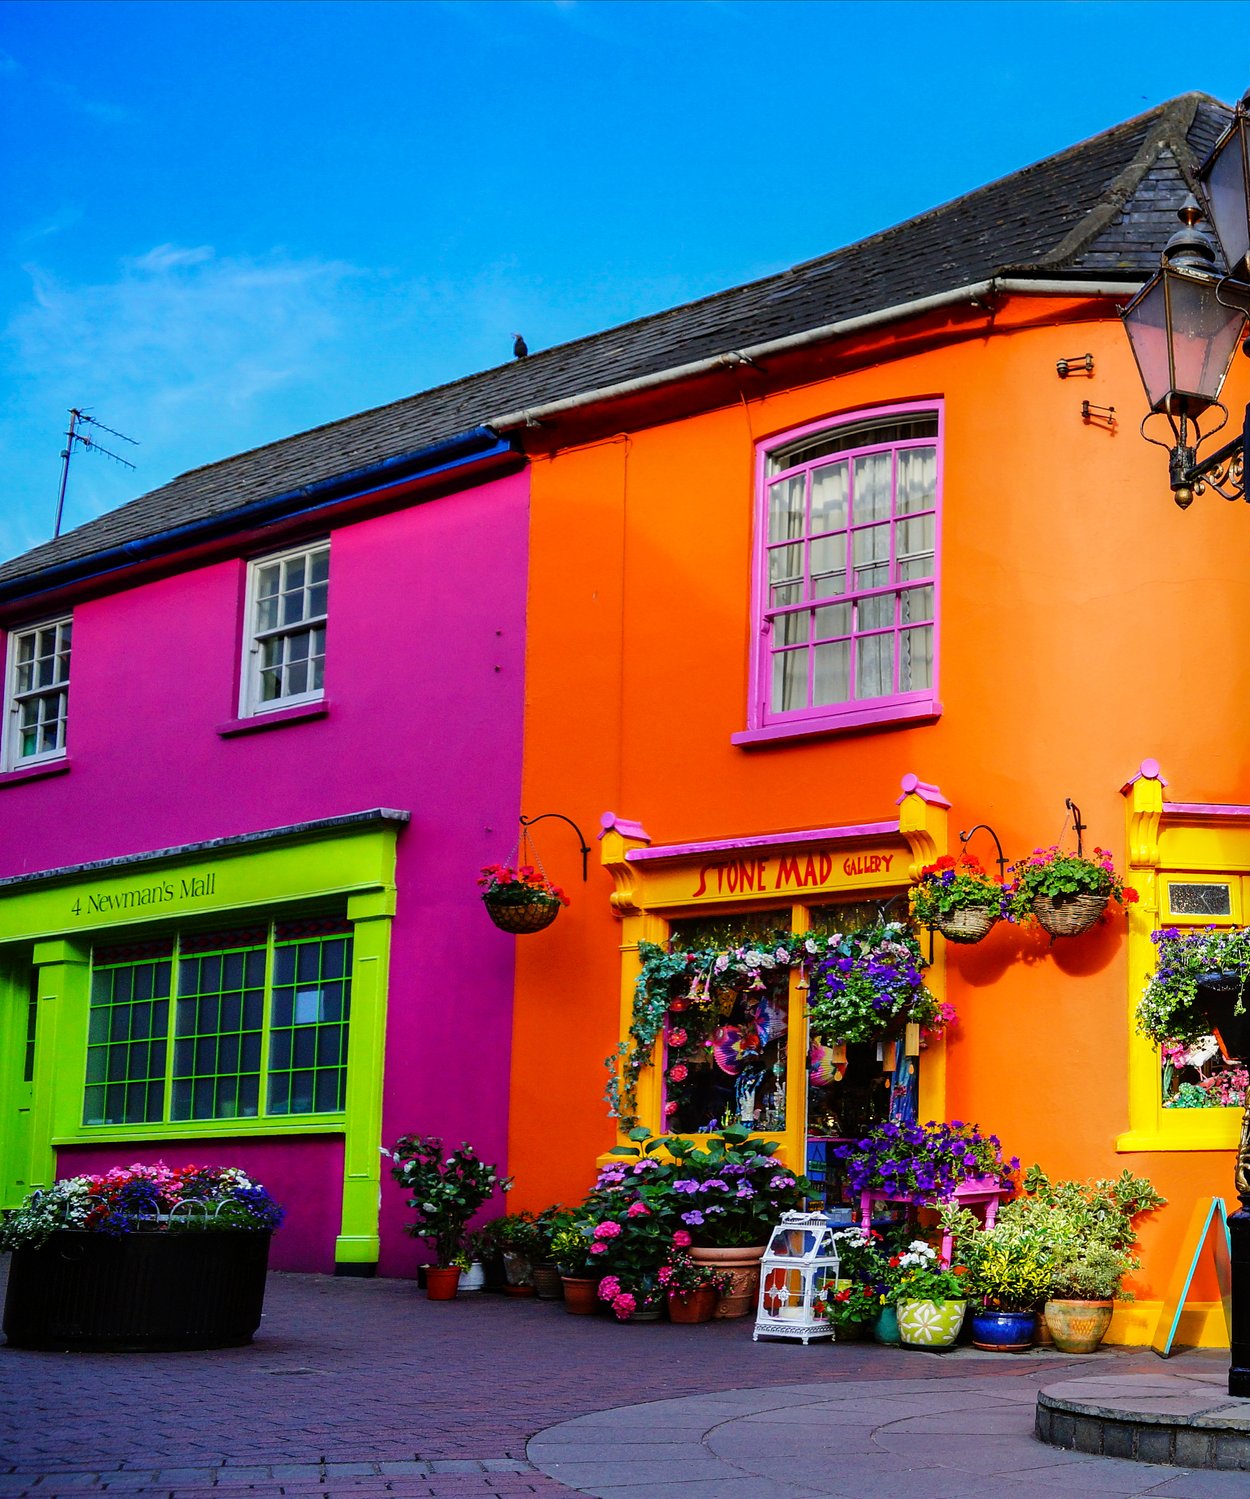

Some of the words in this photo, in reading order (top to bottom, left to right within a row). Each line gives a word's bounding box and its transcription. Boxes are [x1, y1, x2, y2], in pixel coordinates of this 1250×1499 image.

[71, 897, 82, 916] 4
[87, 881, 174, 914] Newman's
[180, 873, 216, 899] Mall
[692, 856, 770, 897] STONE
[775, 850, 833, 889] MAD
[843, 854, 894, 876] GALLERY
